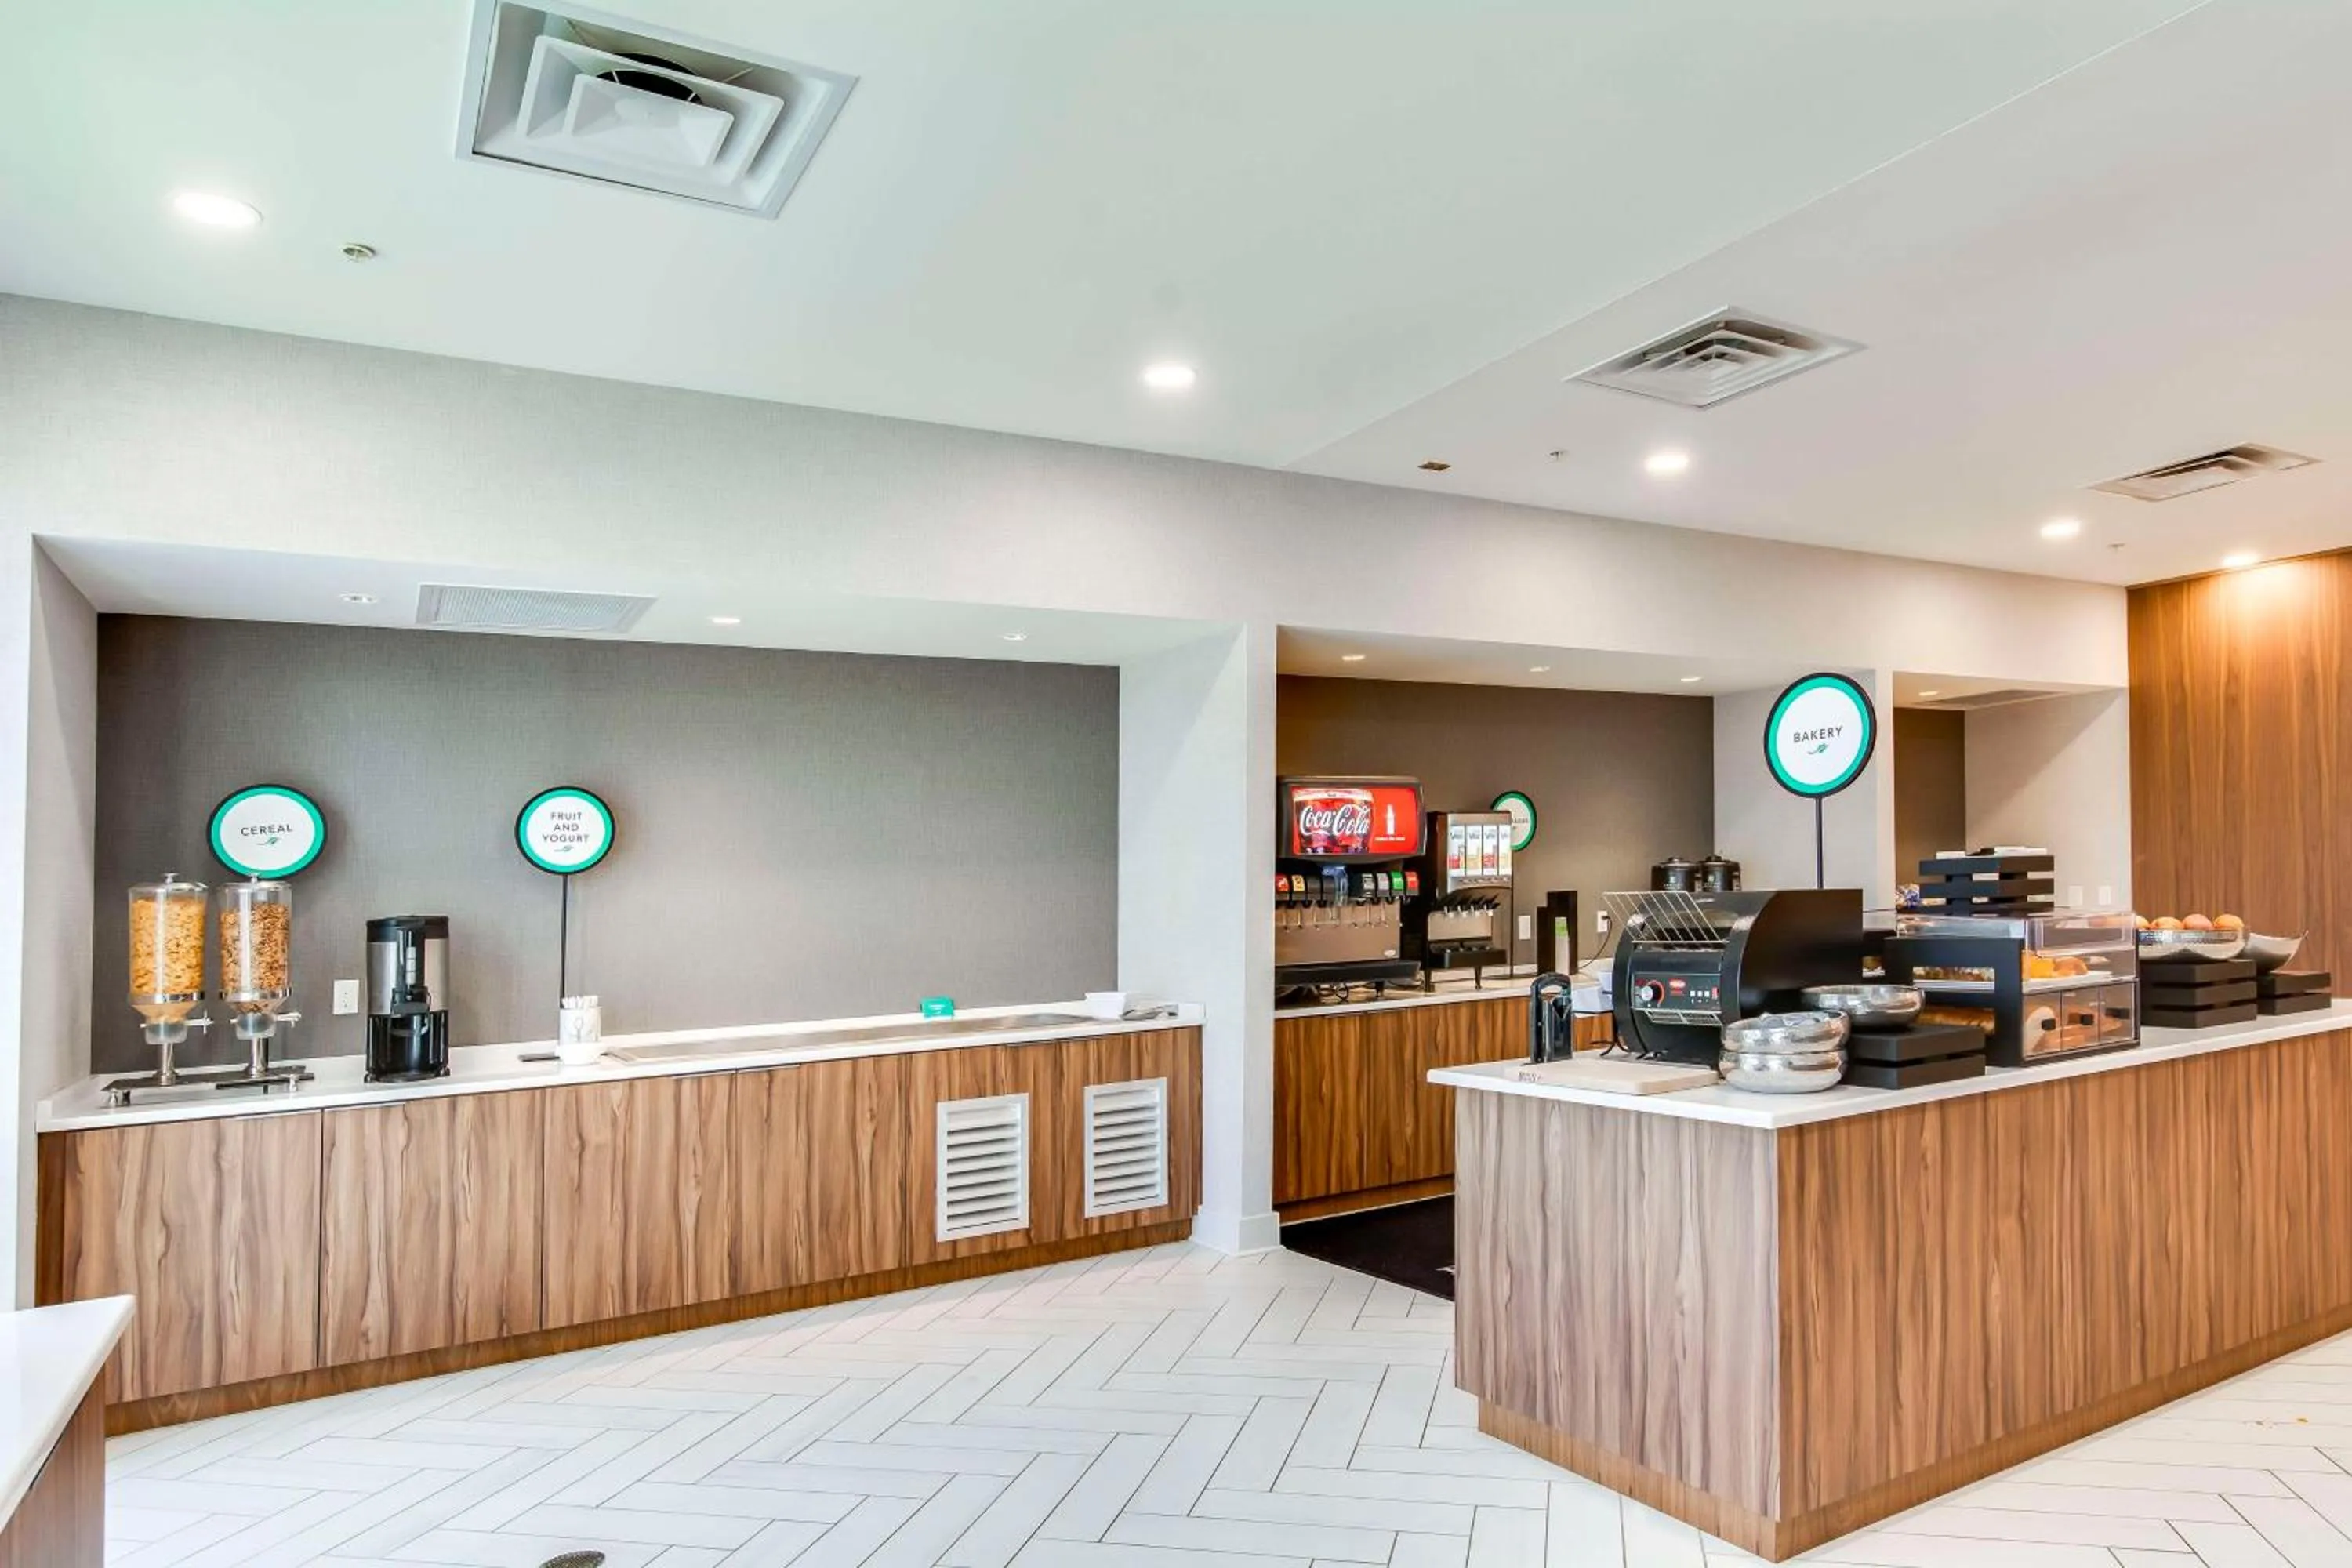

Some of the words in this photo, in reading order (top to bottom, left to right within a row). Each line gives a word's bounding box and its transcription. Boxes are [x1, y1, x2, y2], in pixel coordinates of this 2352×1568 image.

[1793, 725, 1843, 743] BAKERY
[550, 812, 583, 821] FRUIT
[1300, 804, 1370, 837] Coca-Cola
[241, 824, 293, 837] CEREAL
[553, 823, 579, 832] AND
[542, 834, 590, 843] YOGURT
